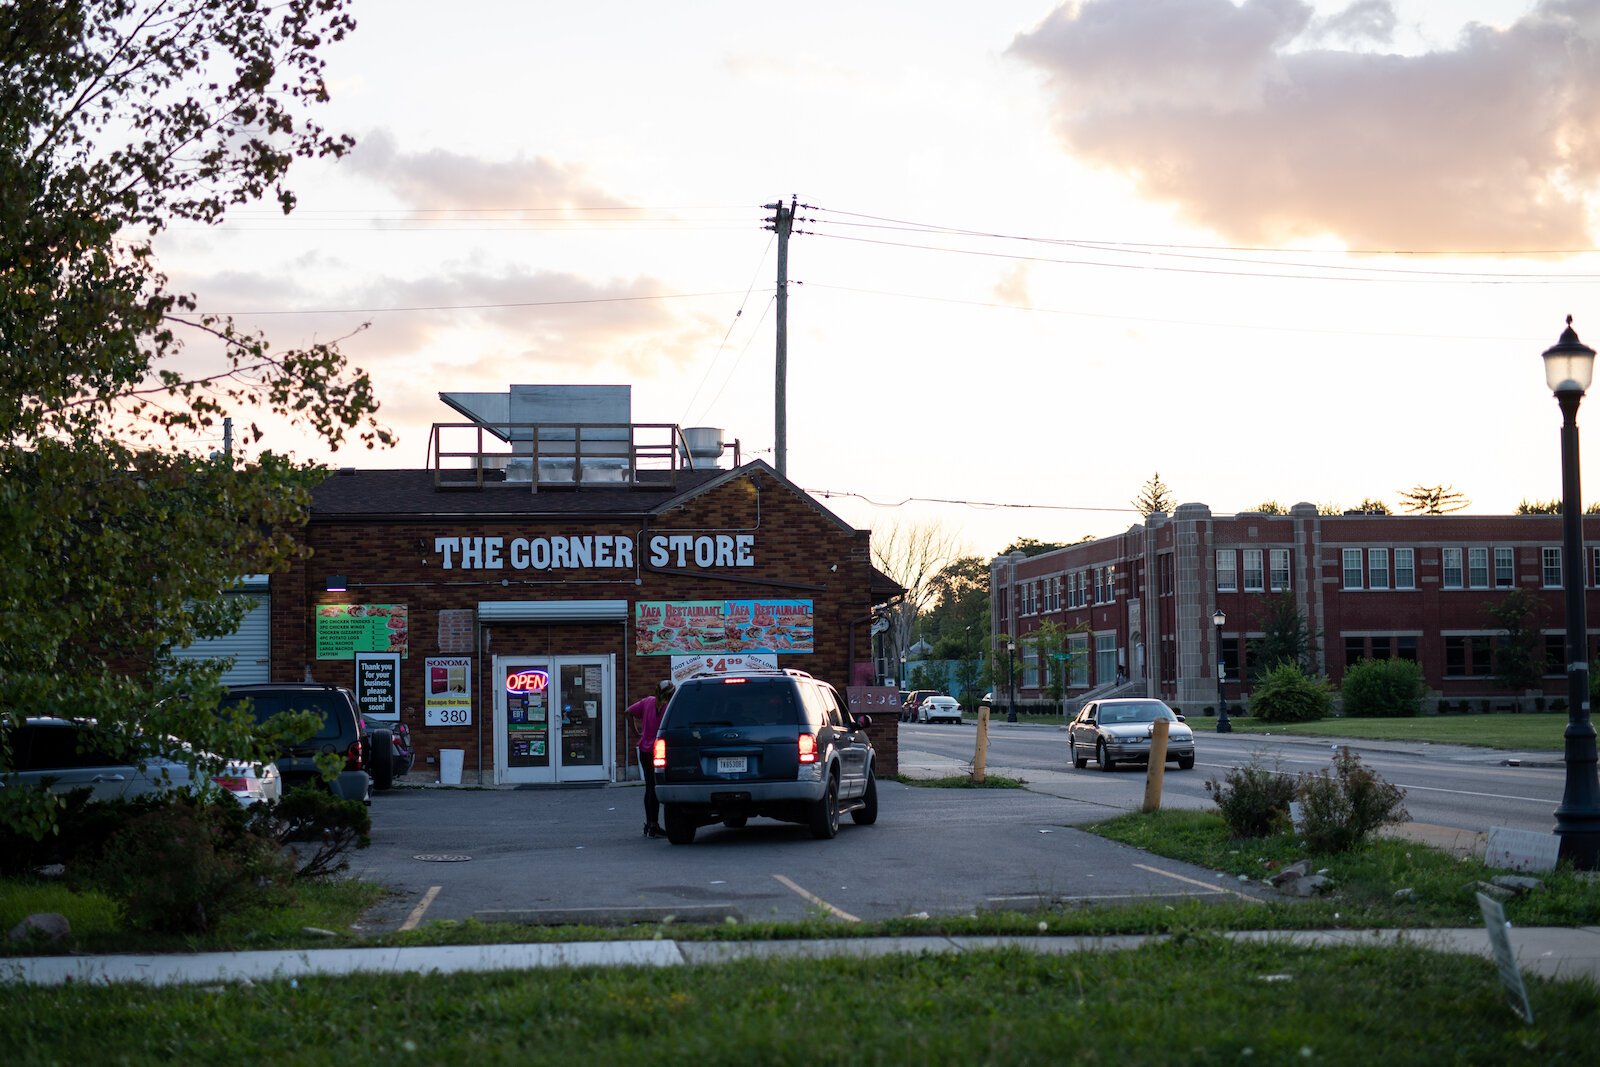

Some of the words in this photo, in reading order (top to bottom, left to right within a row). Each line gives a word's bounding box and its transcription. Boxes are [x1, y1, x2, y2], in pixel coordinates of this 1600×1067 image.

[434, 537, 504, 570] THE
[510, 535, 634, 570] CORNER
[650, 535, 755, 568] STORE
[640, 604, 662, 617] YAFA
[665, 603, 721, 617] RESTAURANT
[728, 603, 750, 616] YAFA
[754, 602, 809, 616] RESTAURANT
[361, 662, 381, 671] Thank
[381, 664, 393, 672] you
[426, 659, 469, 667] SONOMA
[671, 662, 686, 672] FOOT
[685, 655, 702, 665] LONG
[747, 654, 762, 664] FOOT
[762, 660, 777, 670] LONG
[365, 671, 375, 679] for
[375, 672, 390, 681] your
[363, 679, 392, 688] business,
[506, 674, 546, 690] OPEN
[366, 687, 387, 696] please
[378, 694, 393, 703] back
[368, 703, 386, 711] soon!
[428, 710, 433, 718] $
[512, 710, 524, 718] EBT
